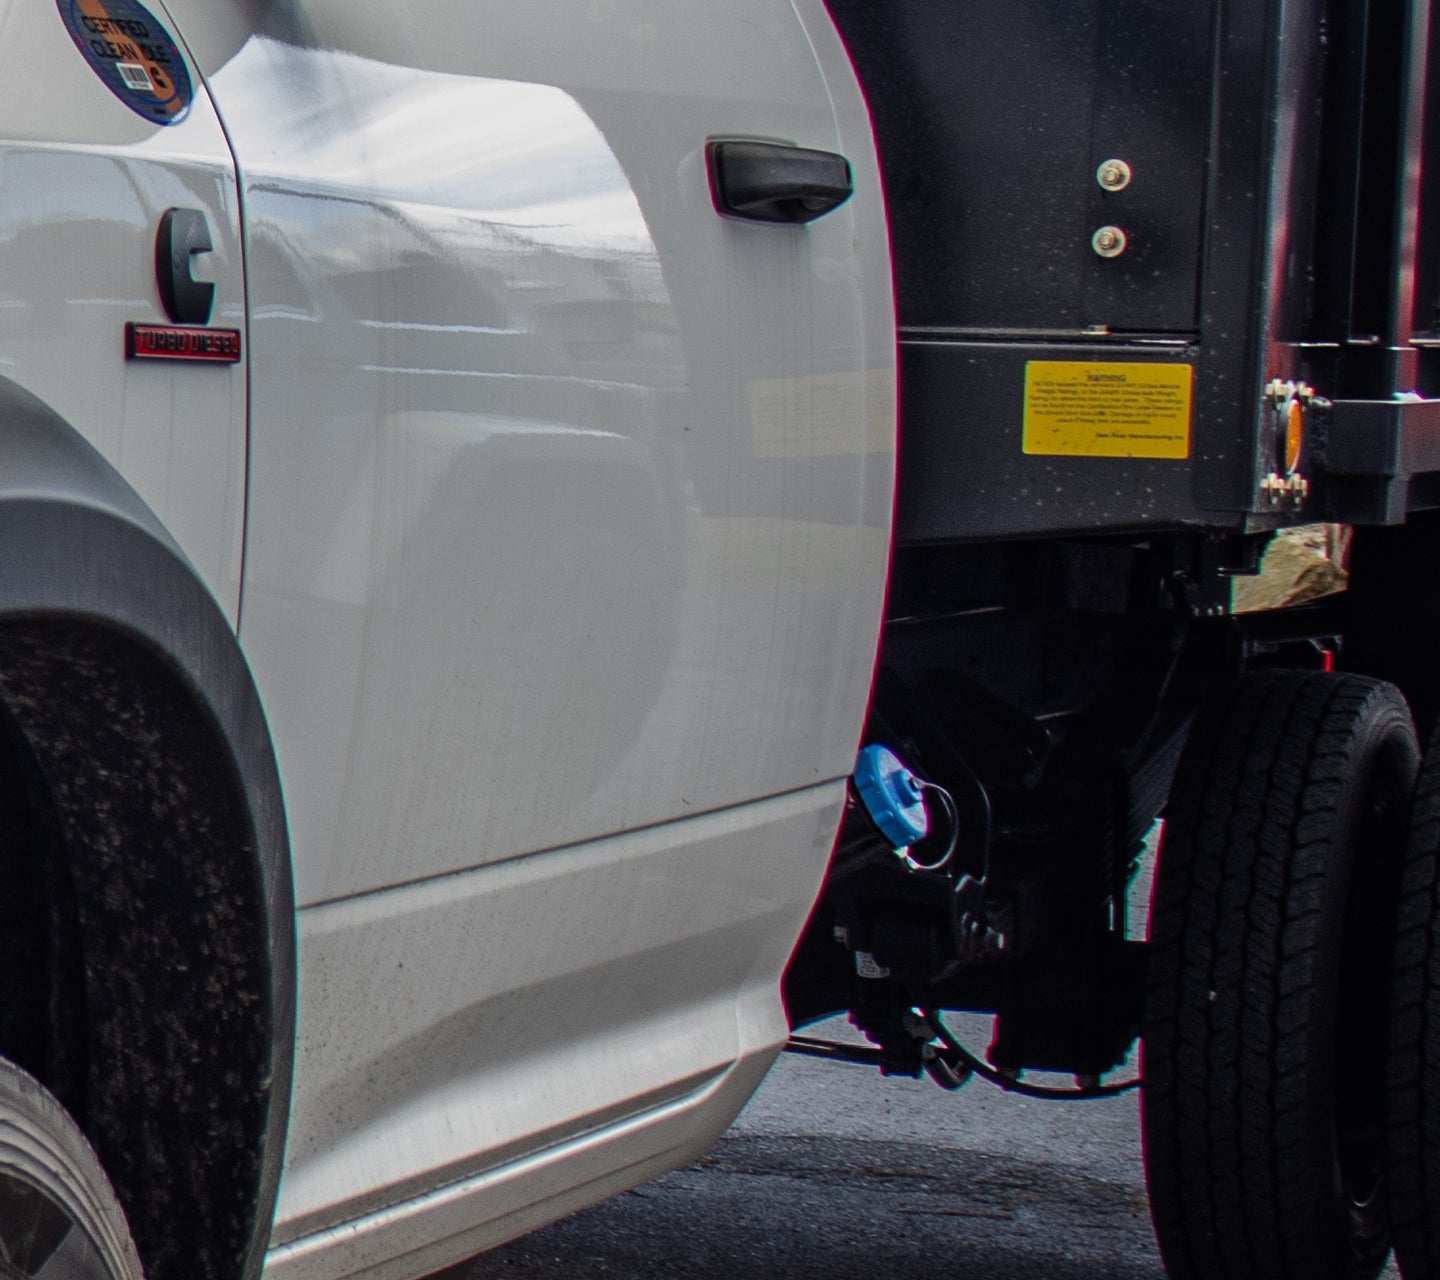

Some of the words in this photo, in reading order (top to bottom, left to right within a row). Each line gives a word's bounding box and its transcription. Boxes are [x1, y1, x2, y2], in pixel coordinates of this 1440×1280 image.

[81, 15, 150, 38] CERTIFIED
[90, 39, 140, 61] CLEAN
[140, 43, 172, 64] IDLE
[140, 330, 187, 351] TURBO
[190, 332, 238, 354] DIESEL
